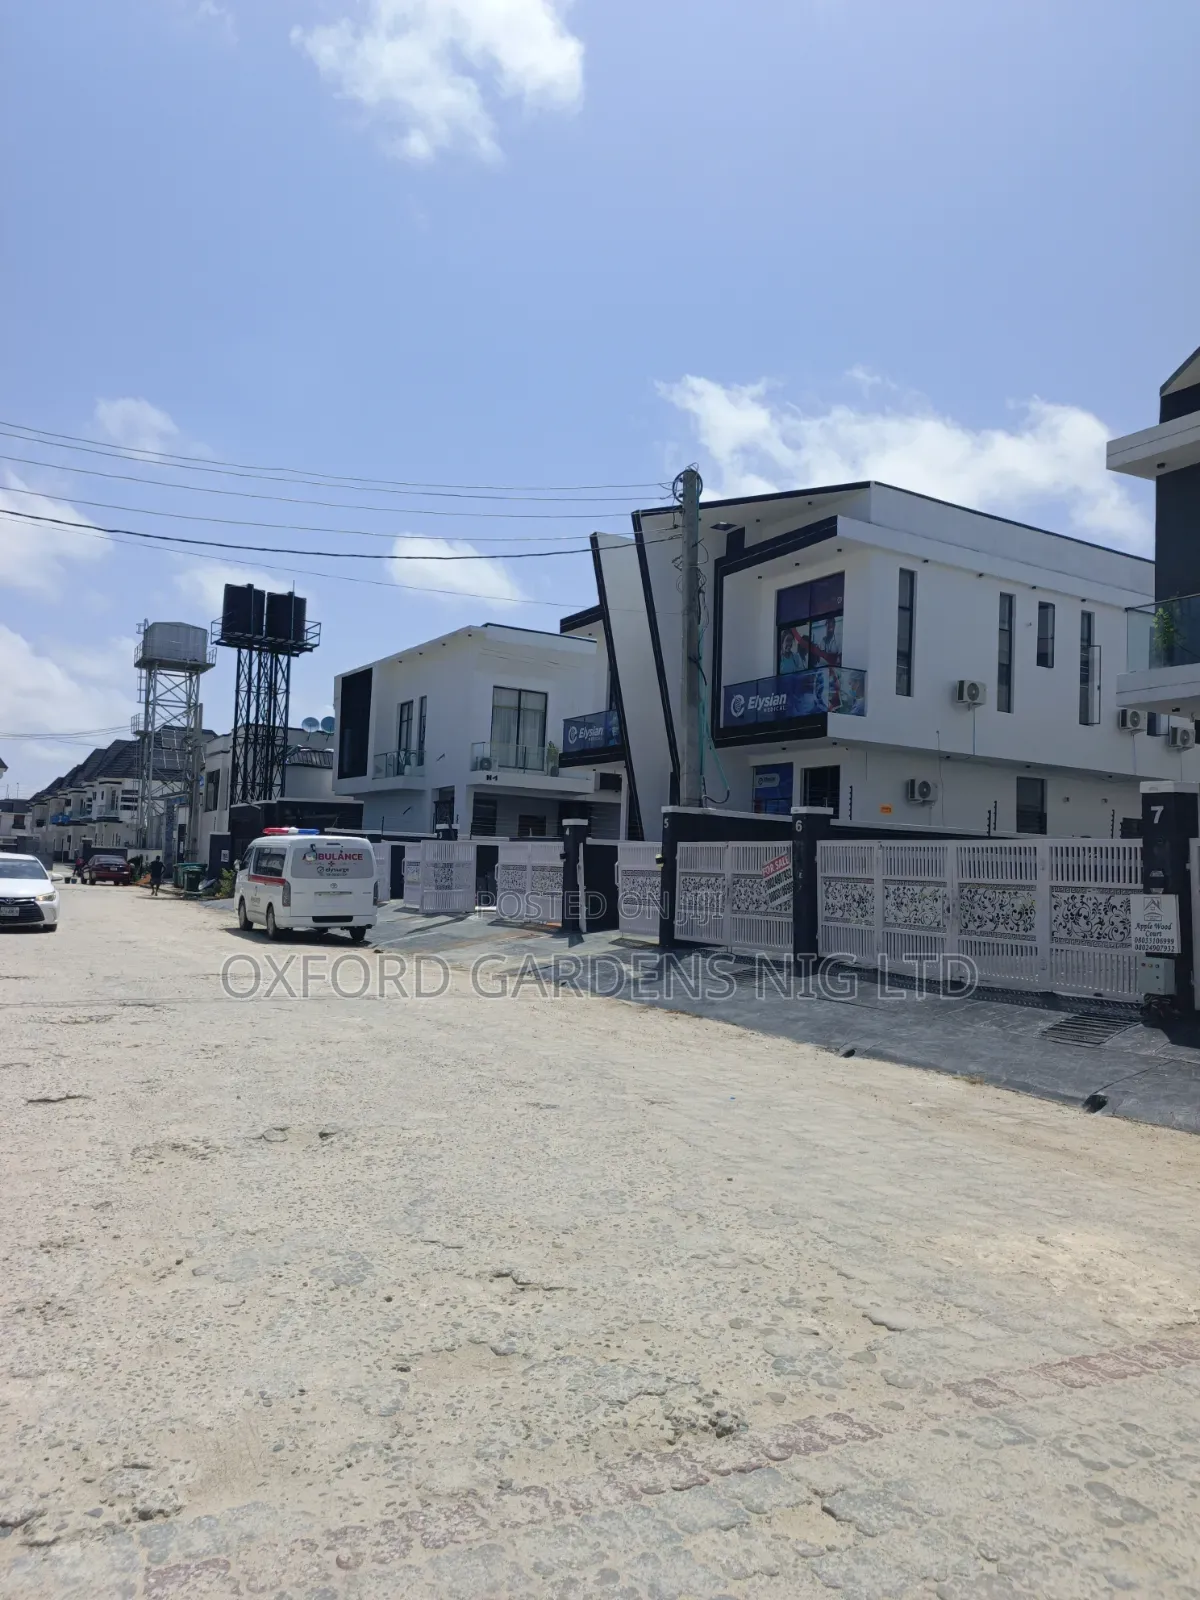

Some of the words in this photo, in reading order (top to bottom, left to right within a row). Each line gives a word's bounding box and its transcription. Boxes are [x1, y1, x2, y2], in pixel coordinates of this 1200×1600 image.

[747, 692, 787, 711] Elysian
[579, 726, 604, 740] Elysian
[1150, 805, 1164, 824] 7
[664, 817, 669, 829] 5
[795, 819, 803, 832] 6
[1134, 922, 1153, 932] Apple
[1154, 922, 1173, 931] Wood
[1145, 930, 1162, 938] Court
